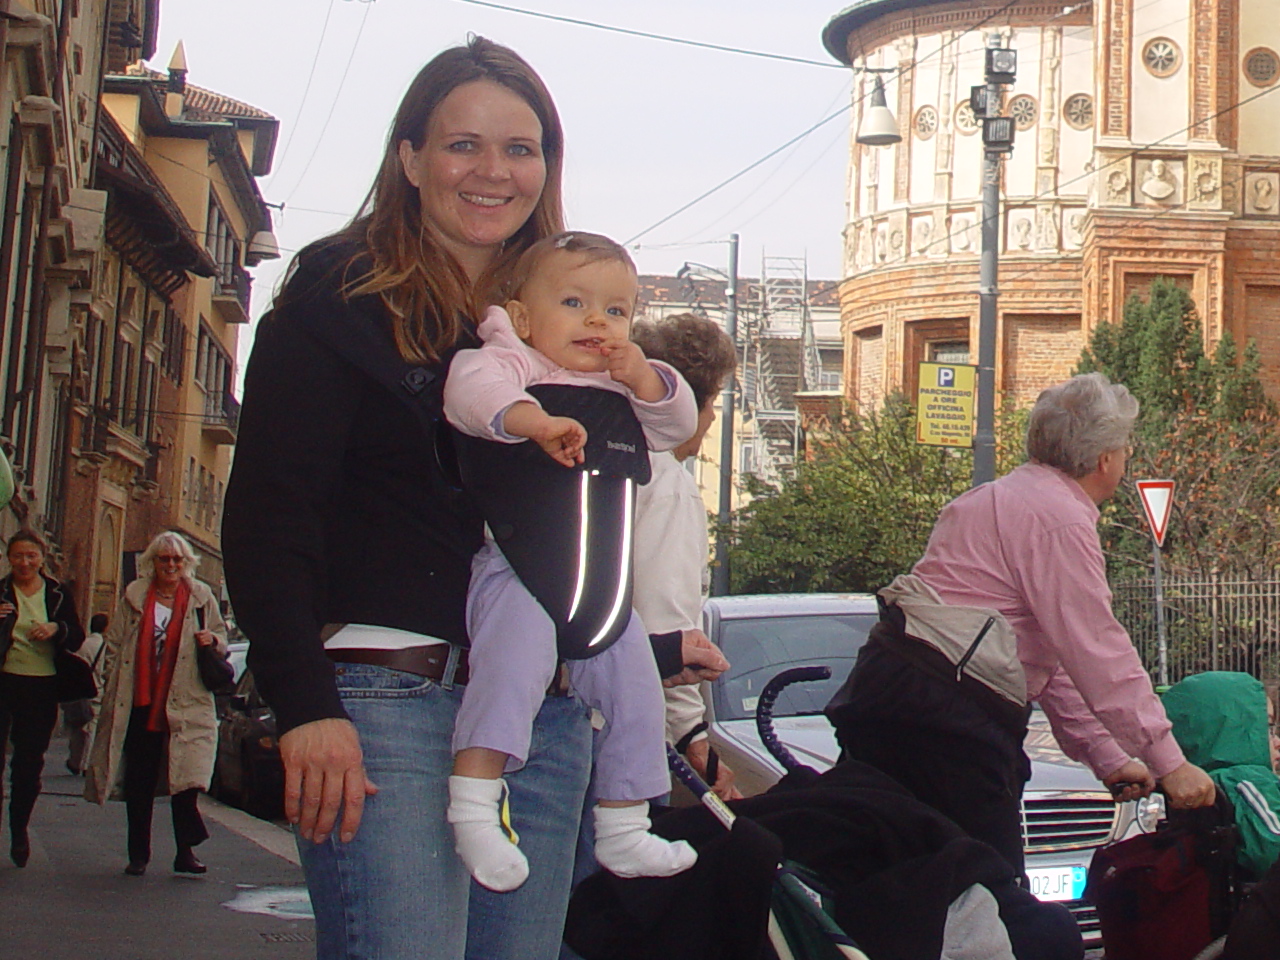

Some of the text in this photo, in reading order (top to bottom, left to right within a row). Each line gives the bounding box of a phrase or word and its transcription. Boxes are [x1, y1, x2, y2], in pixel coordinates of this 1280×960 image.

[940, 369, 953, 385] P
[920, 388, 971, 397] PARCHEGGIO
[927, 404, 964, 412] OFFICINA
[925, 412, 966, 420] LAVAGGIO
